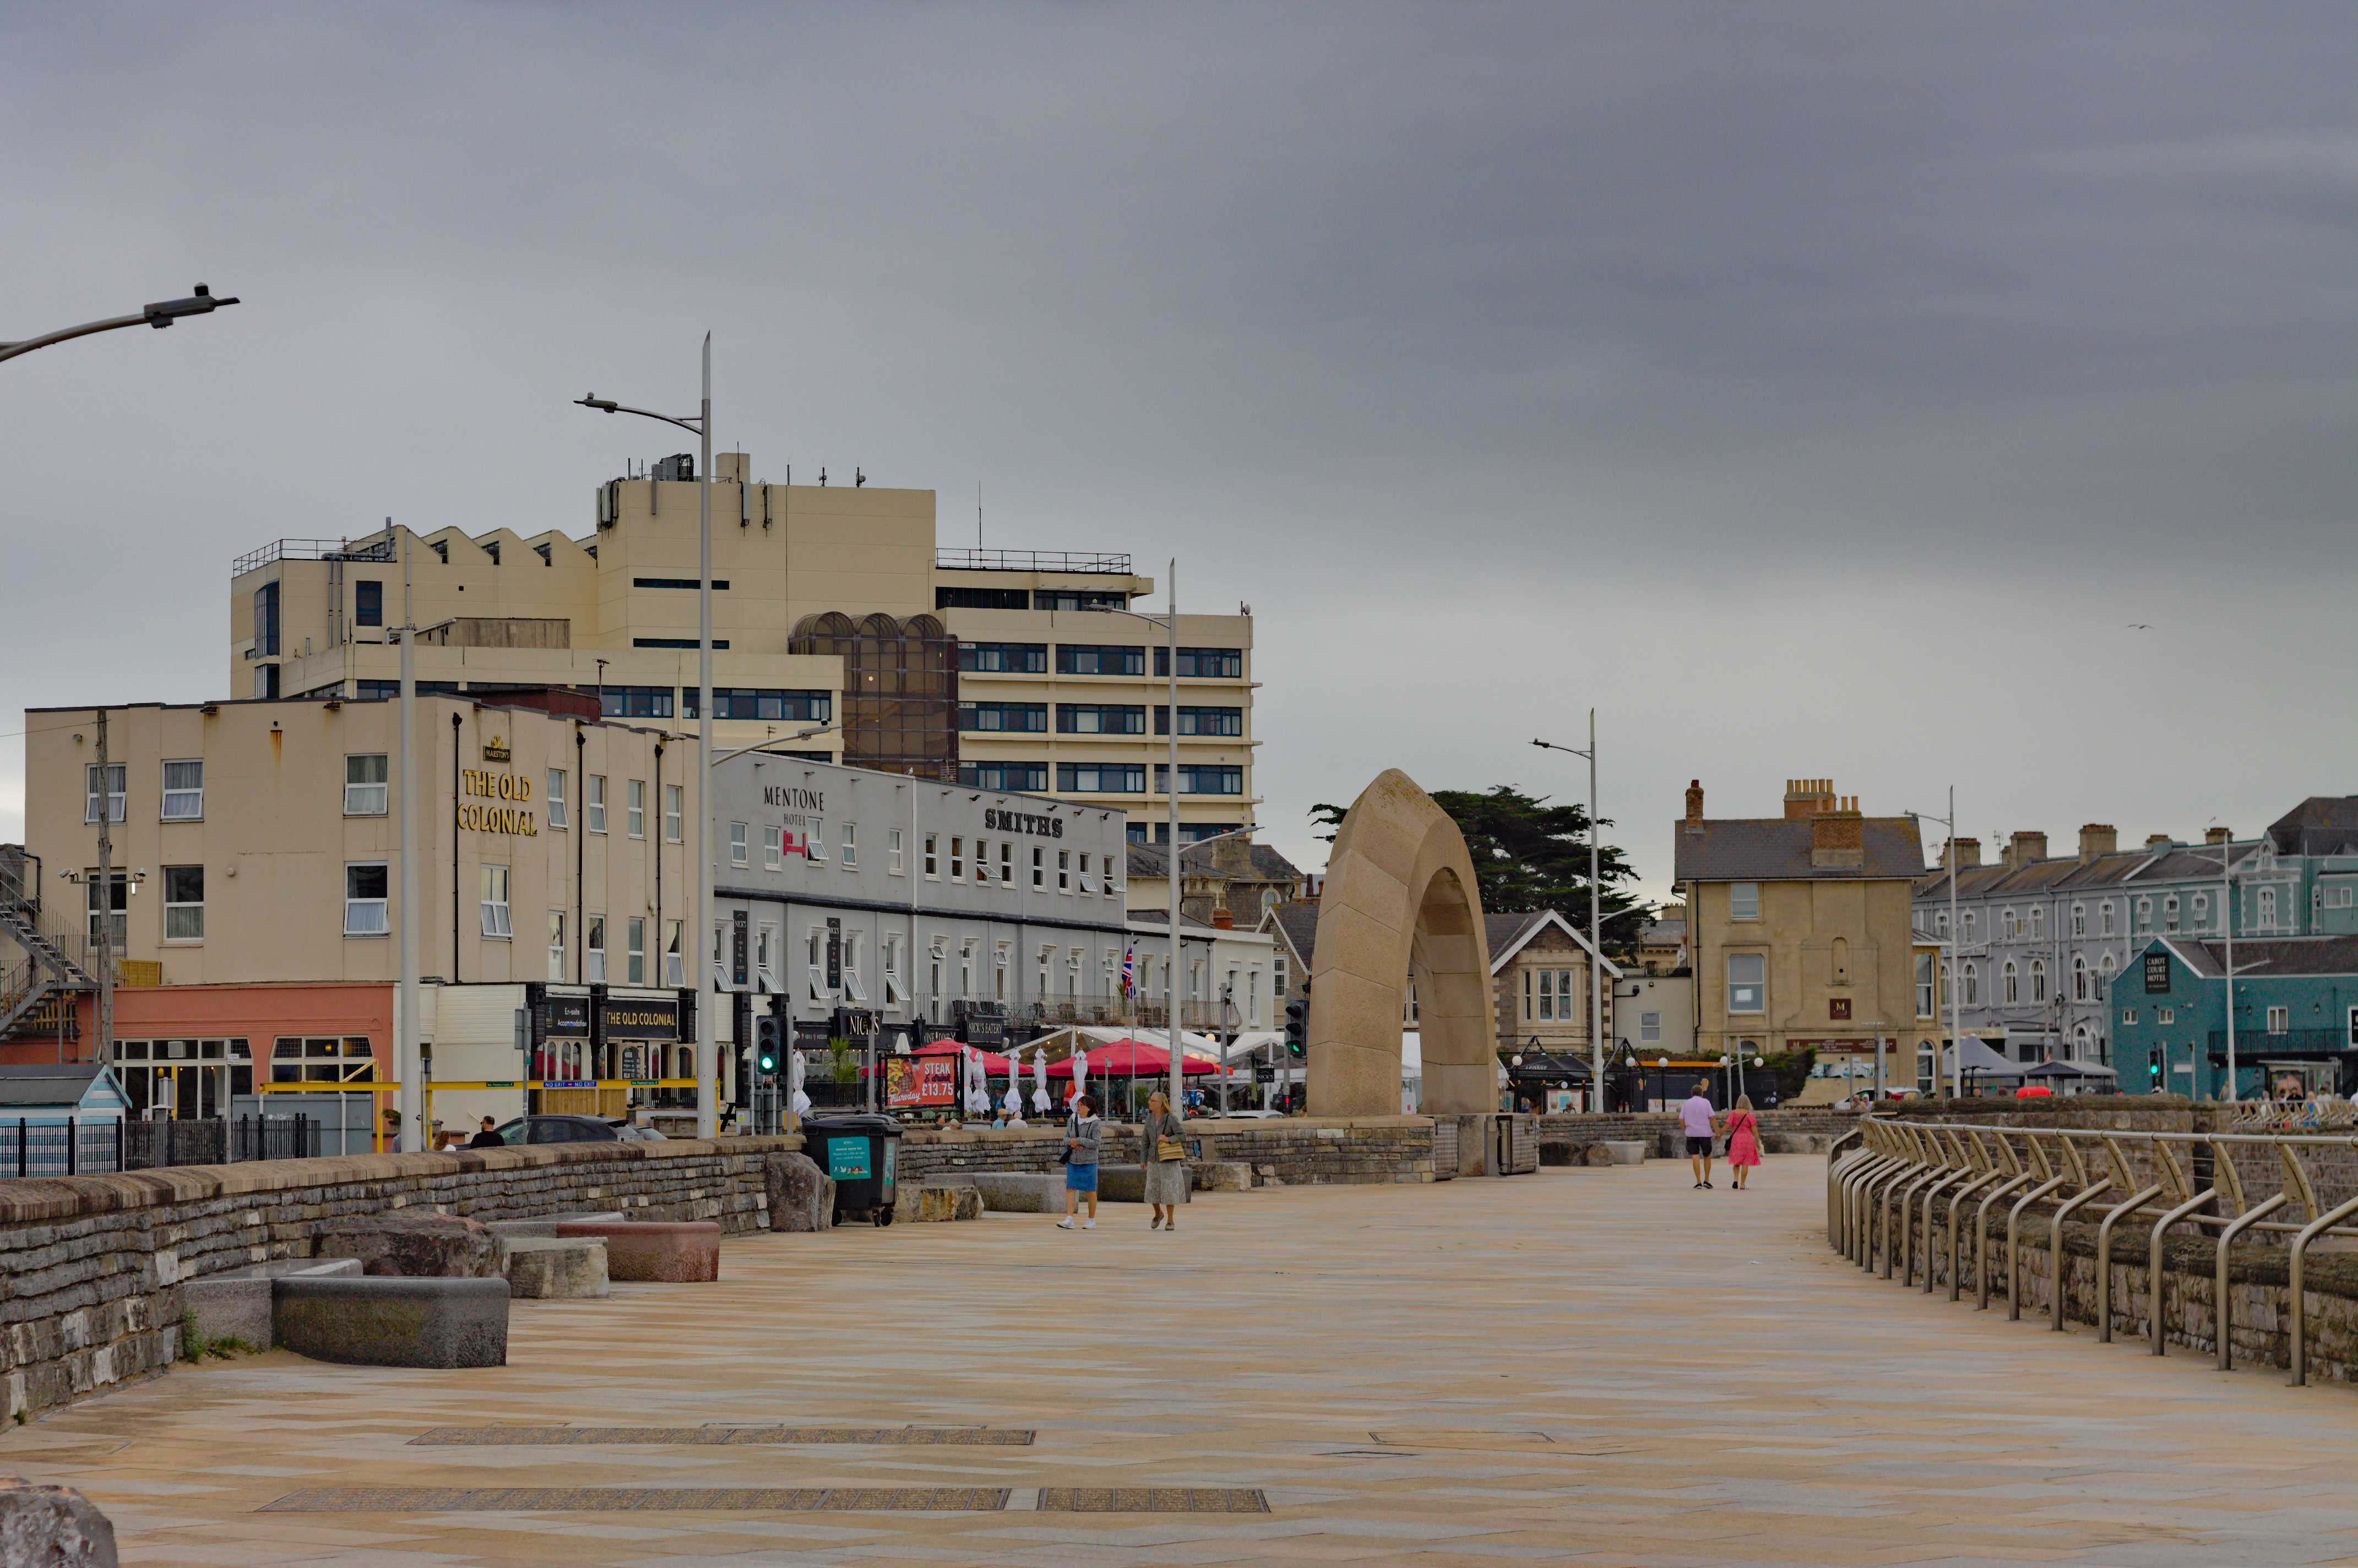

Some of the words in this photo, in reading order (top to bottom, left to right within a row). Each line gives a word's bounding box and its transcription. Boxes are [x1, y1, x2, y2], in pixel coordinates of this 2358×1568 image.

[486, 749, 509, 759] MARSTON'S
[463, 769, 496, 797] THE
[498, 774, 532, 802] OLD
[764, 785, 824, 811] MENTONE
[458, 803, 537, 837] COLONIAL
[784, 813, 806, 826] HOTEL
[985, 808, 1063, 839] SMITHS
[564, 1008, 580, 1016] En-suite
[557, 1019, 587, 1027] Accommodation
[607, 1012, 620, 1025] THE
[622, 1012, 637, 1025] OLD
[639, 1012, 676, 1026] COLONIAL
[850, 1016, 879, 1035] NICS
[969, 1022, 984, 1033] NICK'S
[985, 1023, 1002, 1034] EATERY
[925, 1063, 950, 1075] STEAK
[921, 1083, 954, 1096] £13.75
[888, 1092, 921, 1104] Thursday
